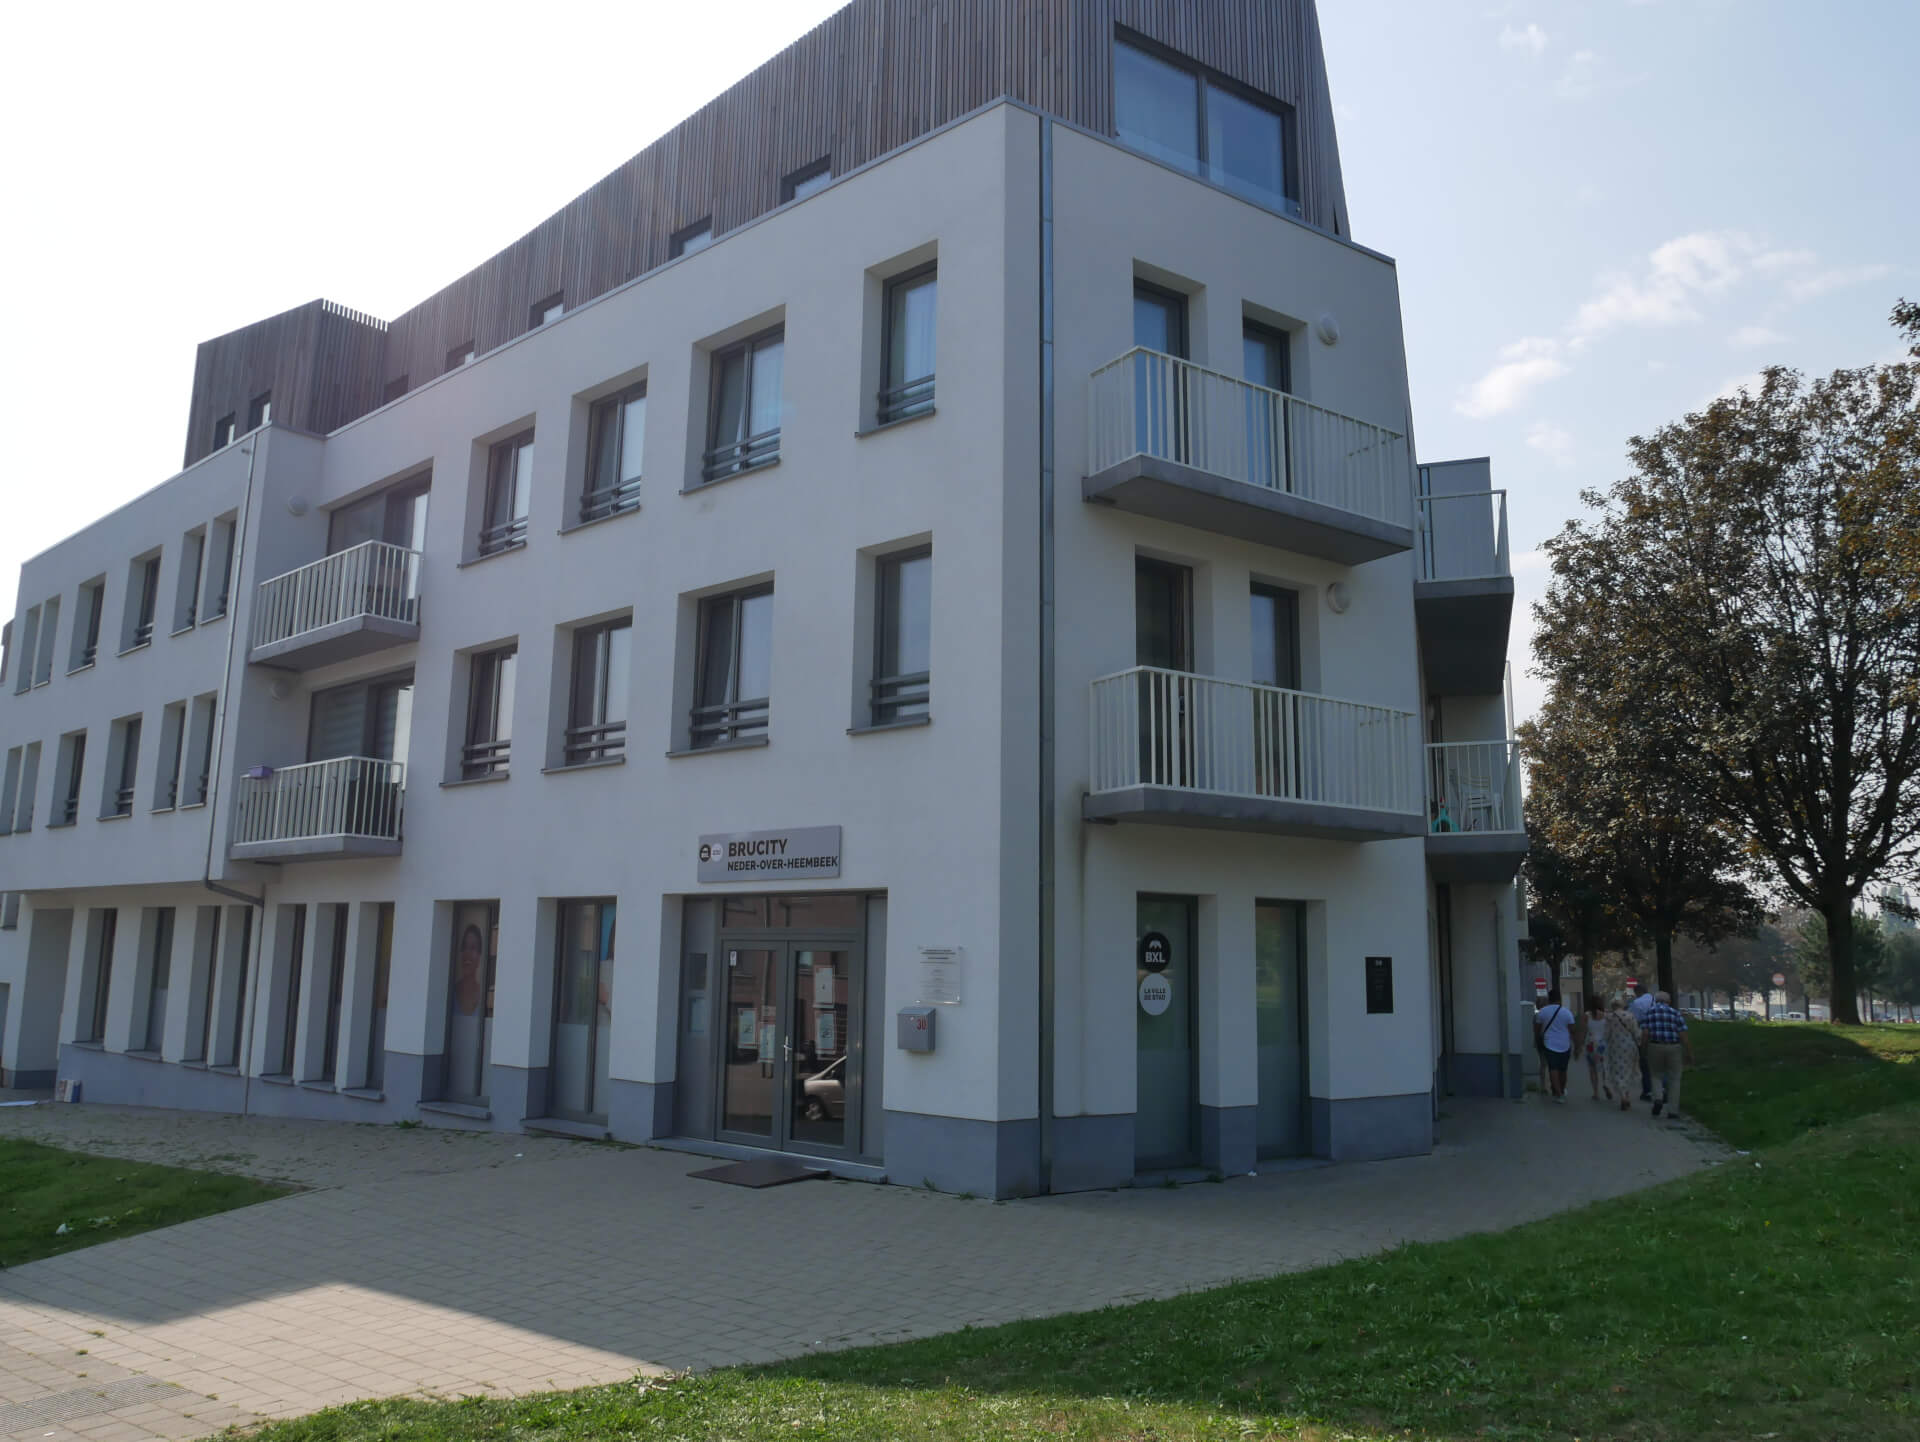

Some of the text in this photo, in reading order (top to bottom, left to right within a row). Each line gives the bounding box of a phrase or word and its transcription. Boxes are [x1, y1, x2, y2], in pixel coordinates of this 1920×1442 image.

[728, 838, 788, 857] BRUCITY
[727, 856, 838, 871] NEDER-OVER-HEEMBEEK
[1145, 951, 1166, 963] BXL
